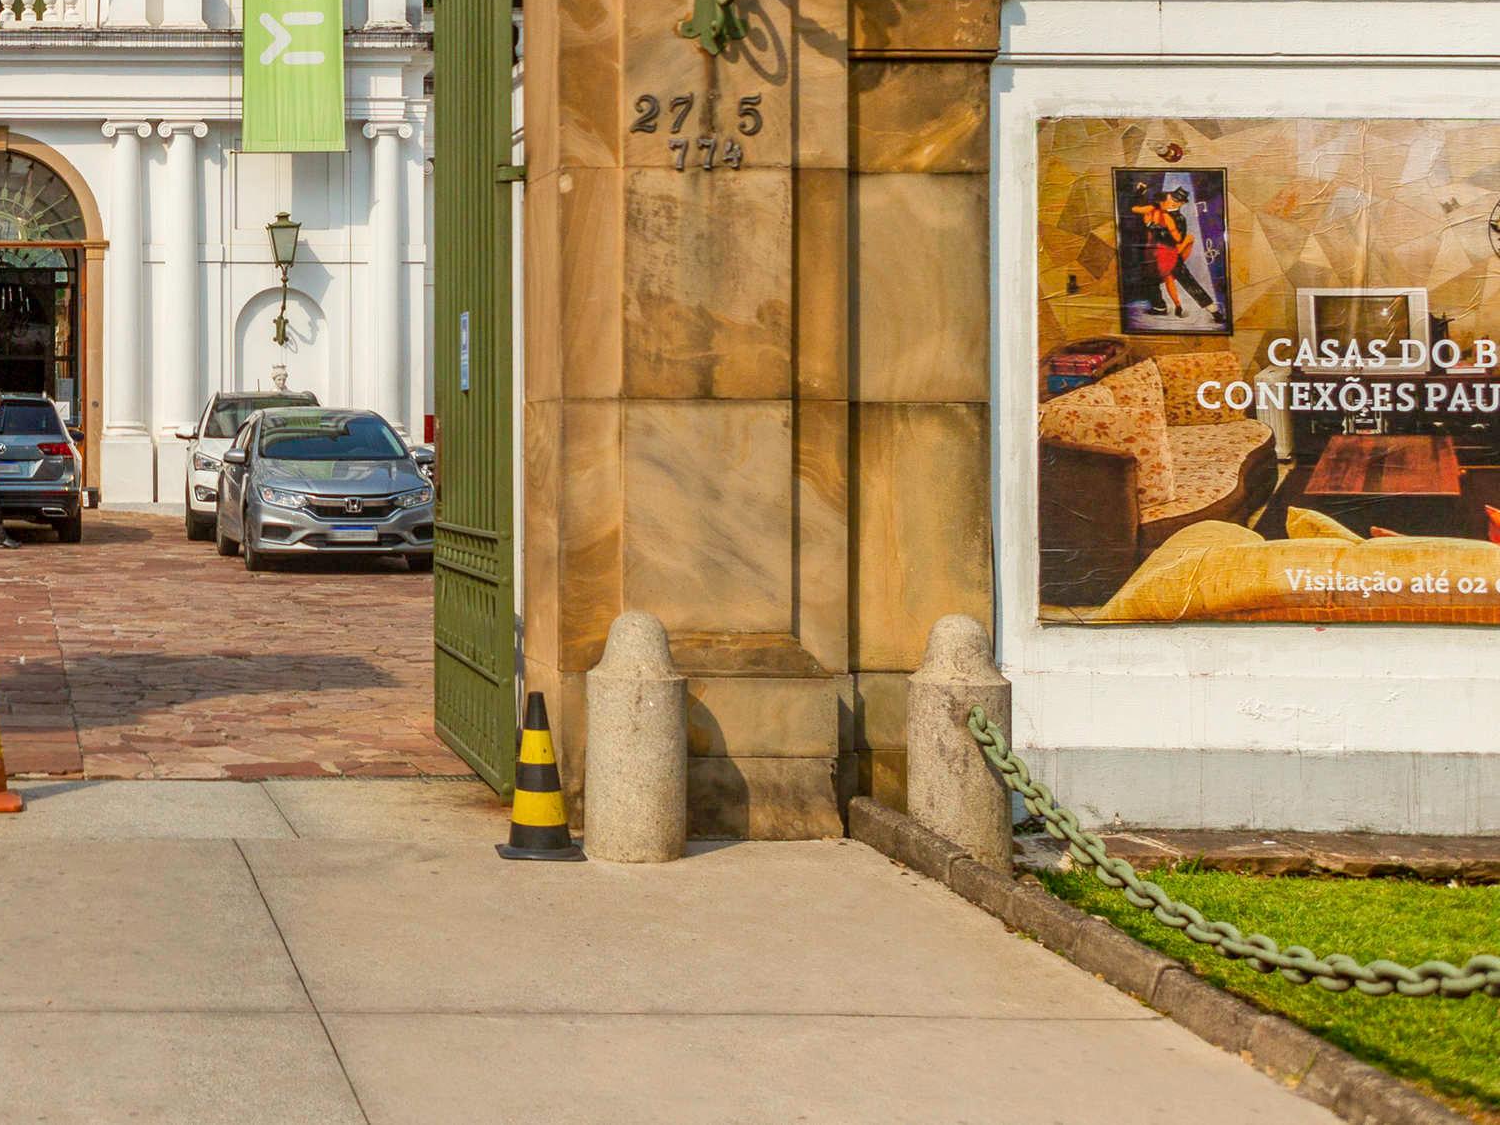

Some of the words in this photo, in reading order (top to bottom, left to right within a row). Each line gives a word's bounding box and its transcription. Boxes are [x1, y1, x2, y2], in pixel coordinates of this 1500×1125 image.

[668, 137, 743, 170] 774
[1267, 338, 1387, 368] CASAS
[1399, 339, 1461, 369] DO
[1196, 376, 1416, 412] CONEXÕES
[1285, 569, 1403, 598] Visitação
[1411, 570, 1450, 594] até
[1457, 577, 1488, 594] 02
